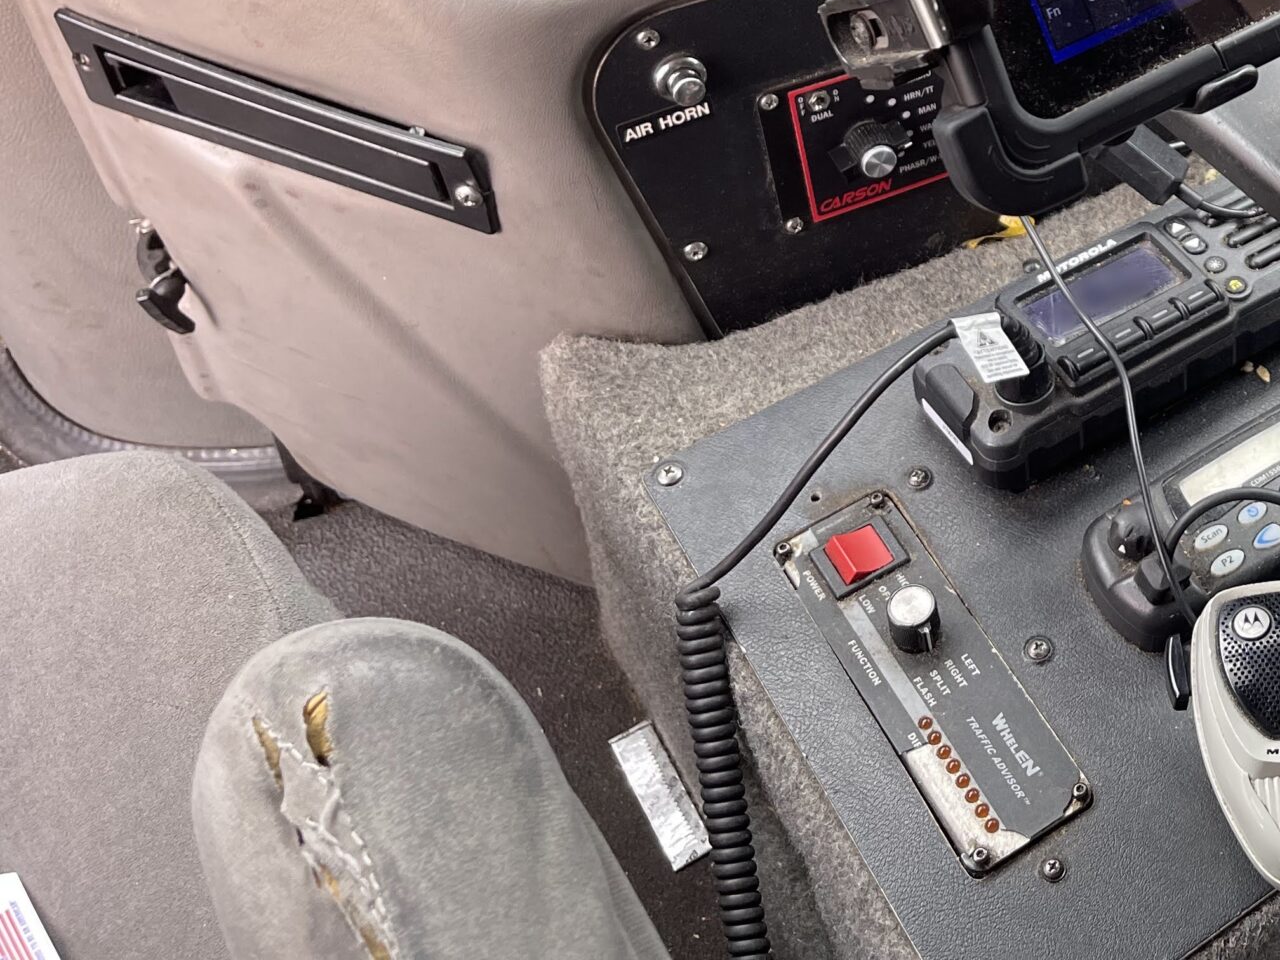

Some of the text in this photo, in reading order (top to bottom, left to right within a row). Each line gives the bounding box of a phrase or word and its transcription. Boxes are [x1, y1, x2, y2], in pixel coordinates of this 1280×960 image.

[1046, 6, 1061, 19] Fn
[903, 84, 935, 101] HRN/TT
[810, 110, 834, 123] DUAL
[918, 103, 937, 115] MAN
[625, 102, 710, 142] AIR HORN
[920, 123, 933, 133] WA
[820, 178, 893, 212] CARSON
[1036, 238, 1117, 283] MTOROLA
[1200, 526, 1223, 544] Scan
[1221, 555, 1234, 567] P2
[802, 570, 826, 600] POWER
[858, 594, 876, 614] LOW
[847, 640, 882, 686] FUNCTION
[944, 659, 968, 688] RIGHT
[961, 653, 981, 676] LEFT
[913, 677, 937, 707] FLASH
[930, 669, 951, 696] SPLIT
[966, 716, 997, 755] TRAFFIC
